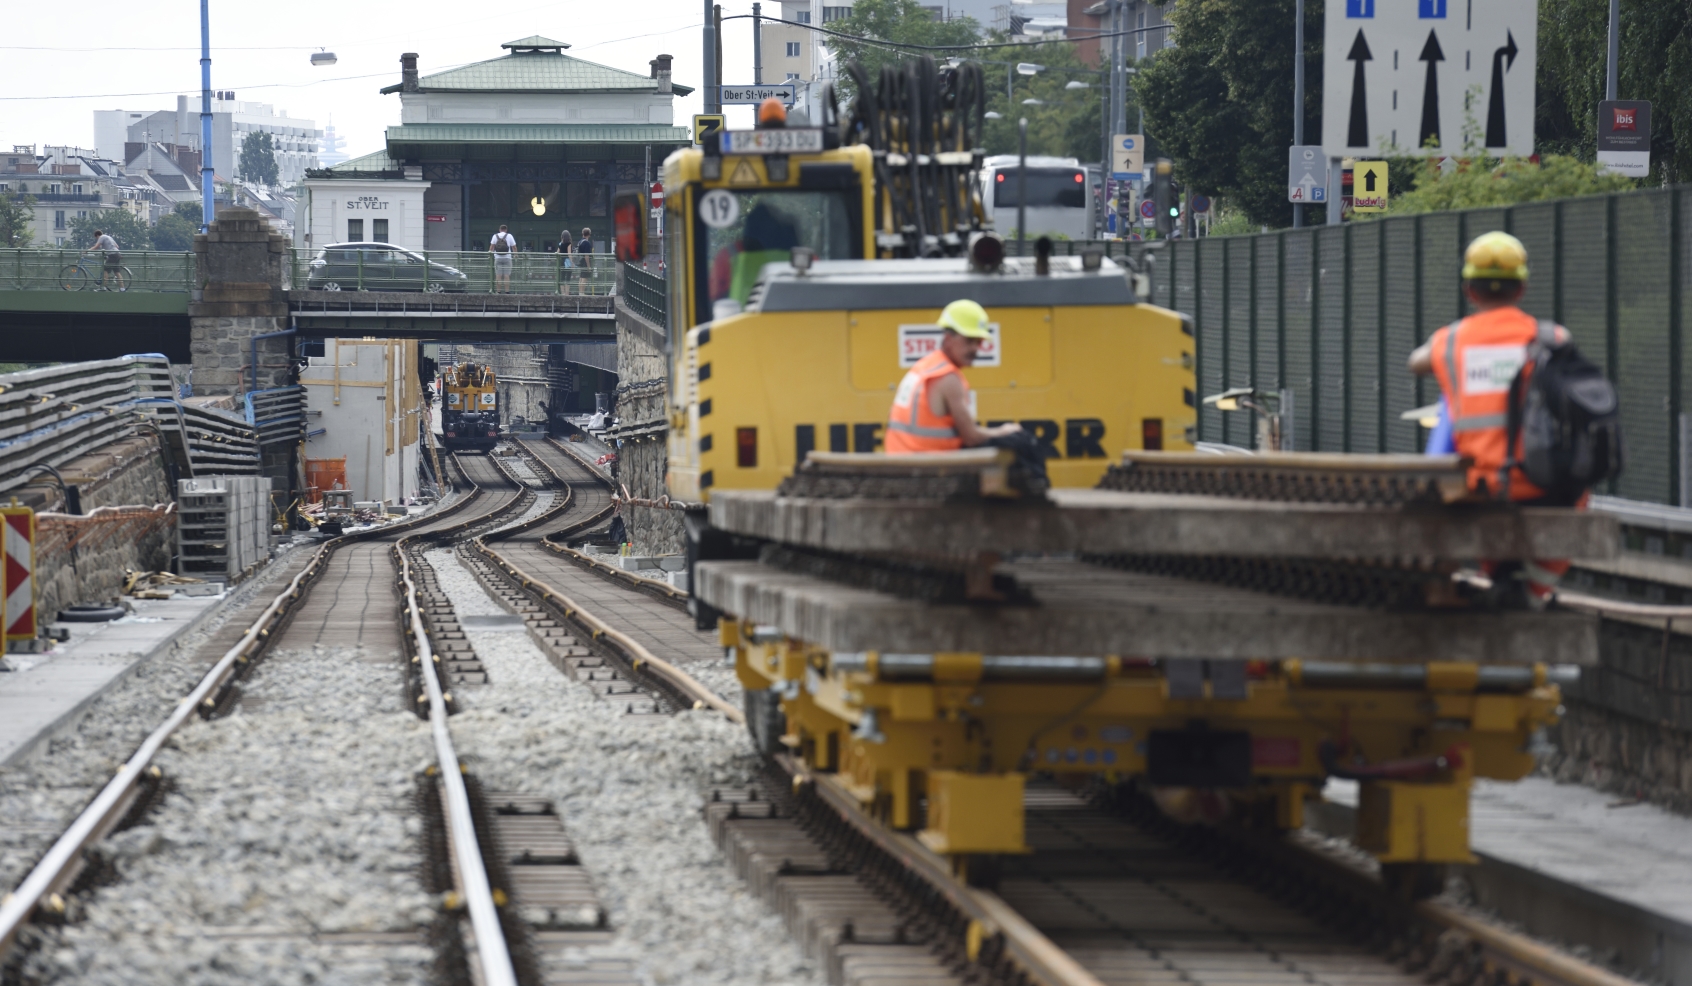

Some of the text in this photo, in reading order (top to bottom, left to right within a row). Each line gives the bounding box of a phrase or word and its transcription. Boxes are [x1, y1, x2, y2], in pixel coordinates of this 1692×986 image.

[724, 90, 743, 100] Ober
[1616, 114, 1633, 124] ibis
[1355, 196, 1386, 208] Ludwig
[708, 195, 731, 221] 19
